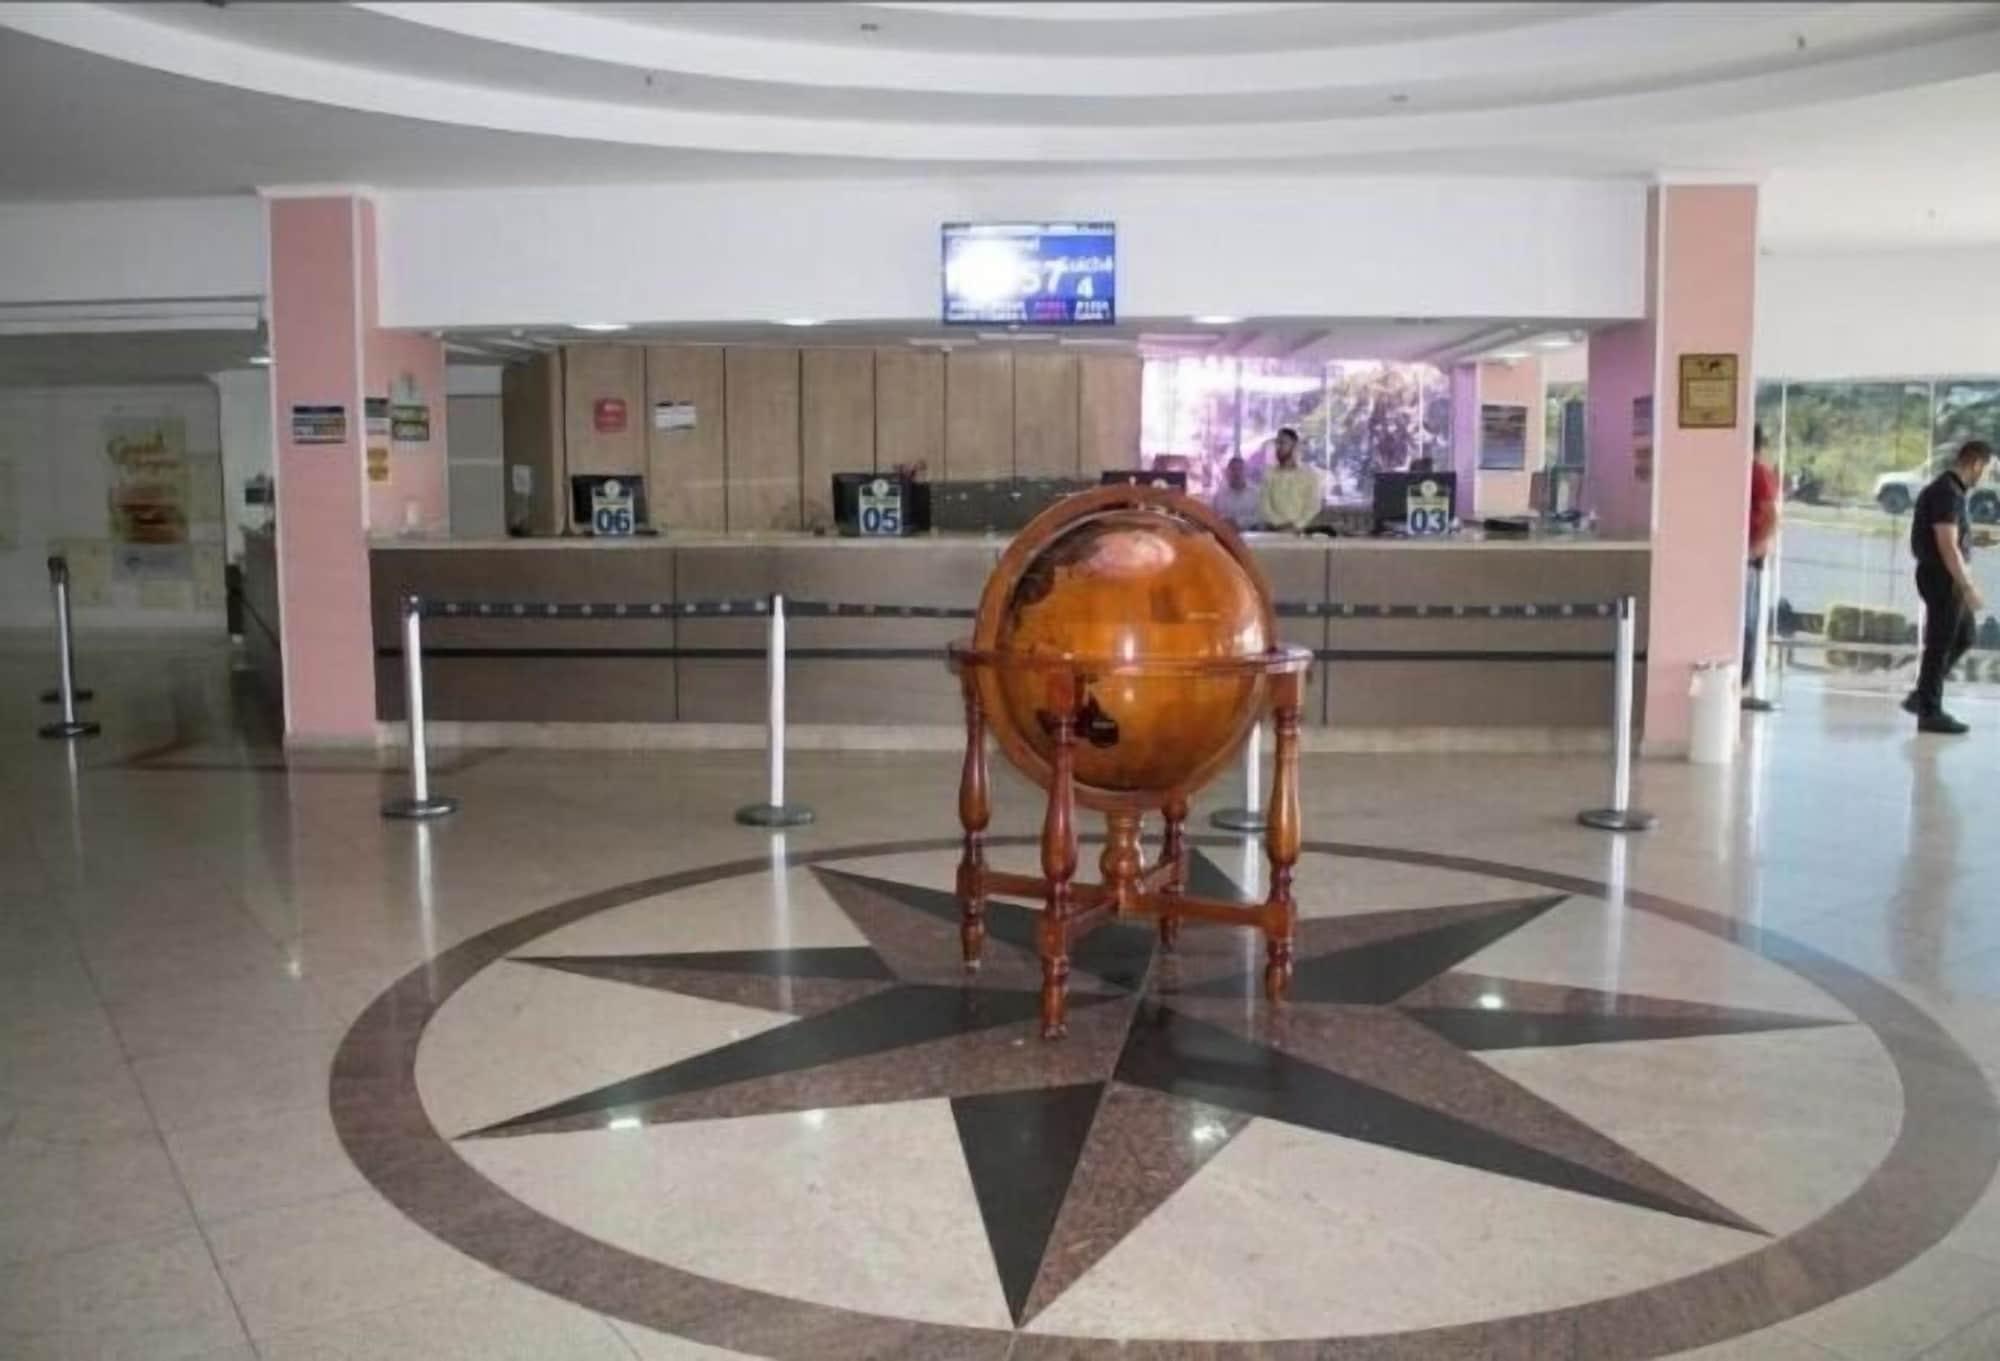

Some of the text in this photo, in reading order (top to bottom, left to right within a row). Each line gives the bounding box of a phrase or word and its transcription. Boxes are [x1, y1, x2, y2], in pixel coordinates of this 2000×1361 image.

[1076, 275, 1094, 298] 4
[597, 507, 630, 533] 06
[863, 507, 898, 532] 05
[1411, 507, 1446, 533] 03
